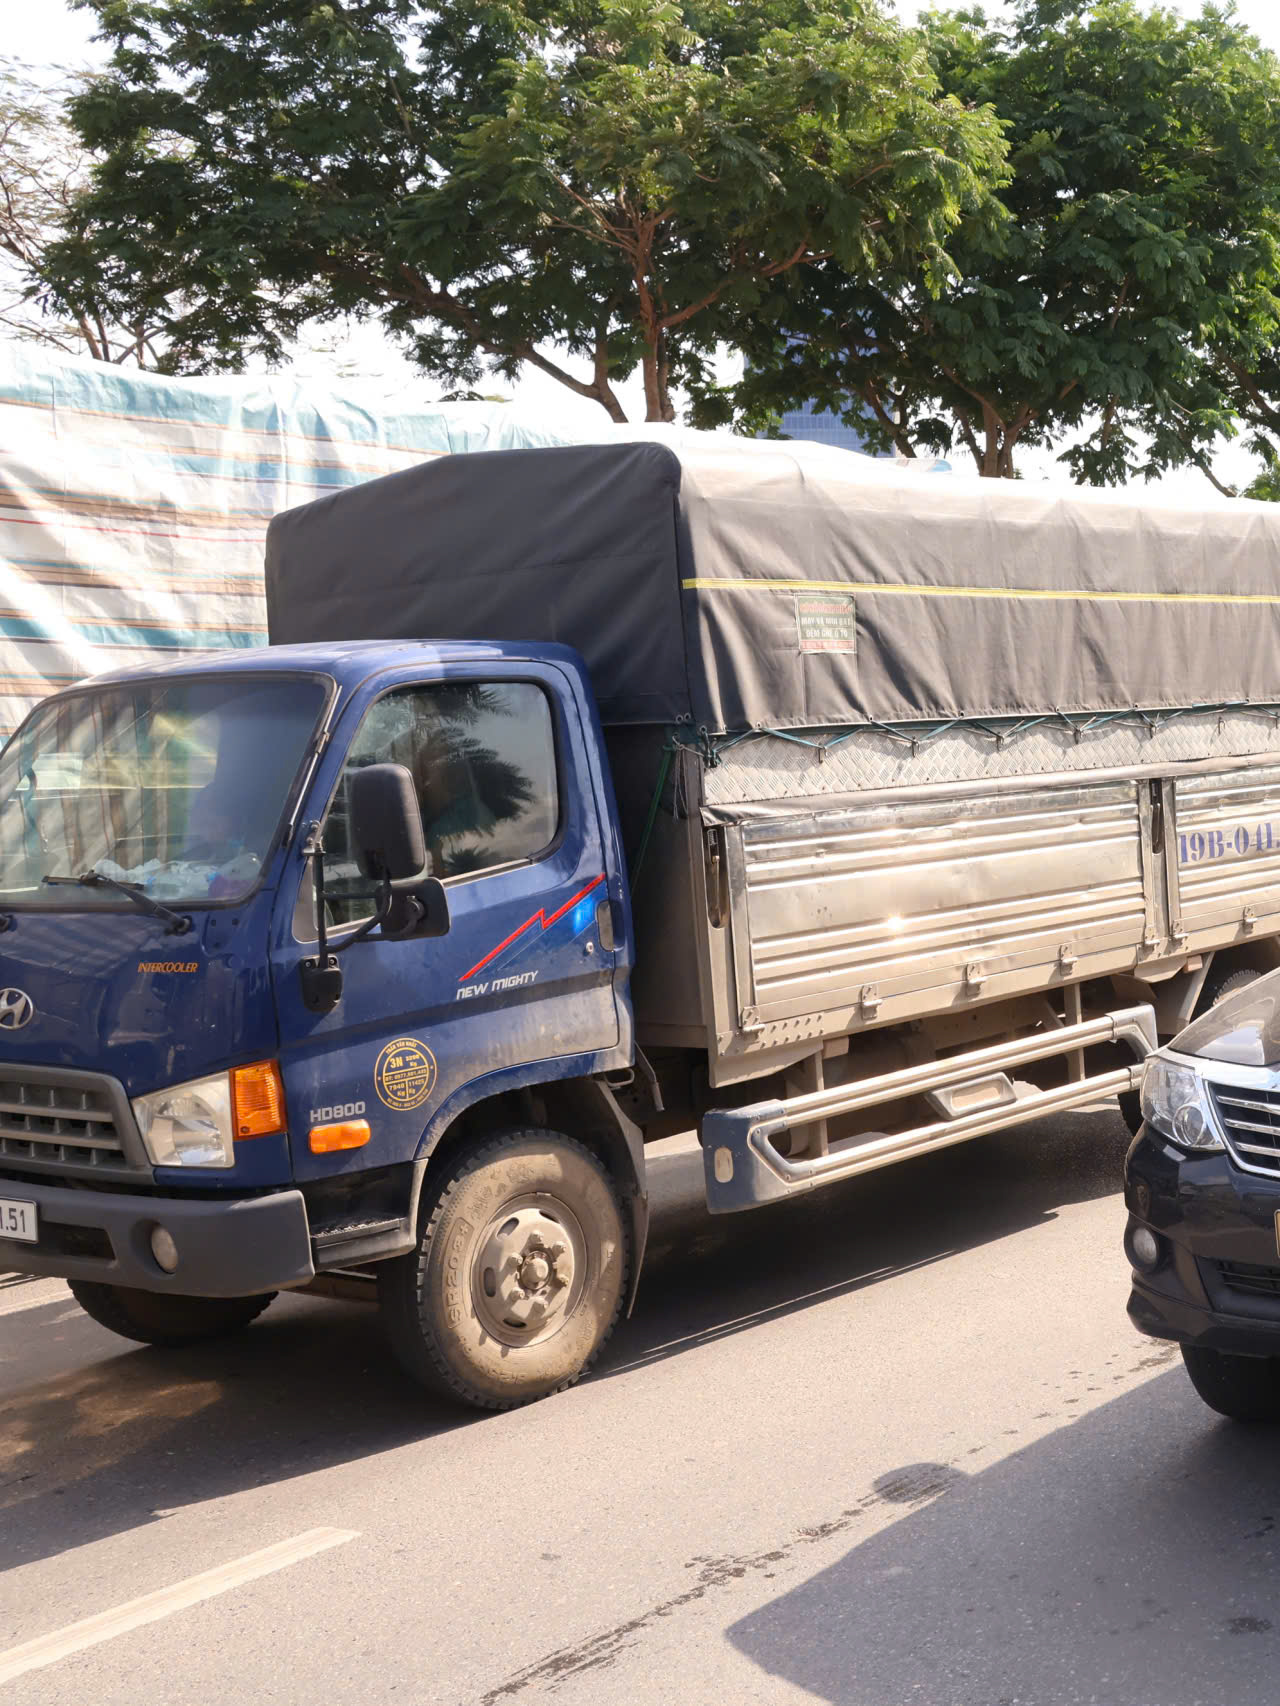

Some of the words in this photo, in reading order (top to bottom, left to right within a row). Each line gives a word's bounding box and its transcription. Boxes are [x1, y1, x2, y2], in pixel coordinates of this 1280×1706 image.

[137, 961, 199, 973] INTERCOOLER
[455, 981, 489, 1001] NEW
[492, 970, 539, 990] MIGHTY
[390, 1056, 403, 1068] 3N
[309, 1101, 366, 1123] HD800
